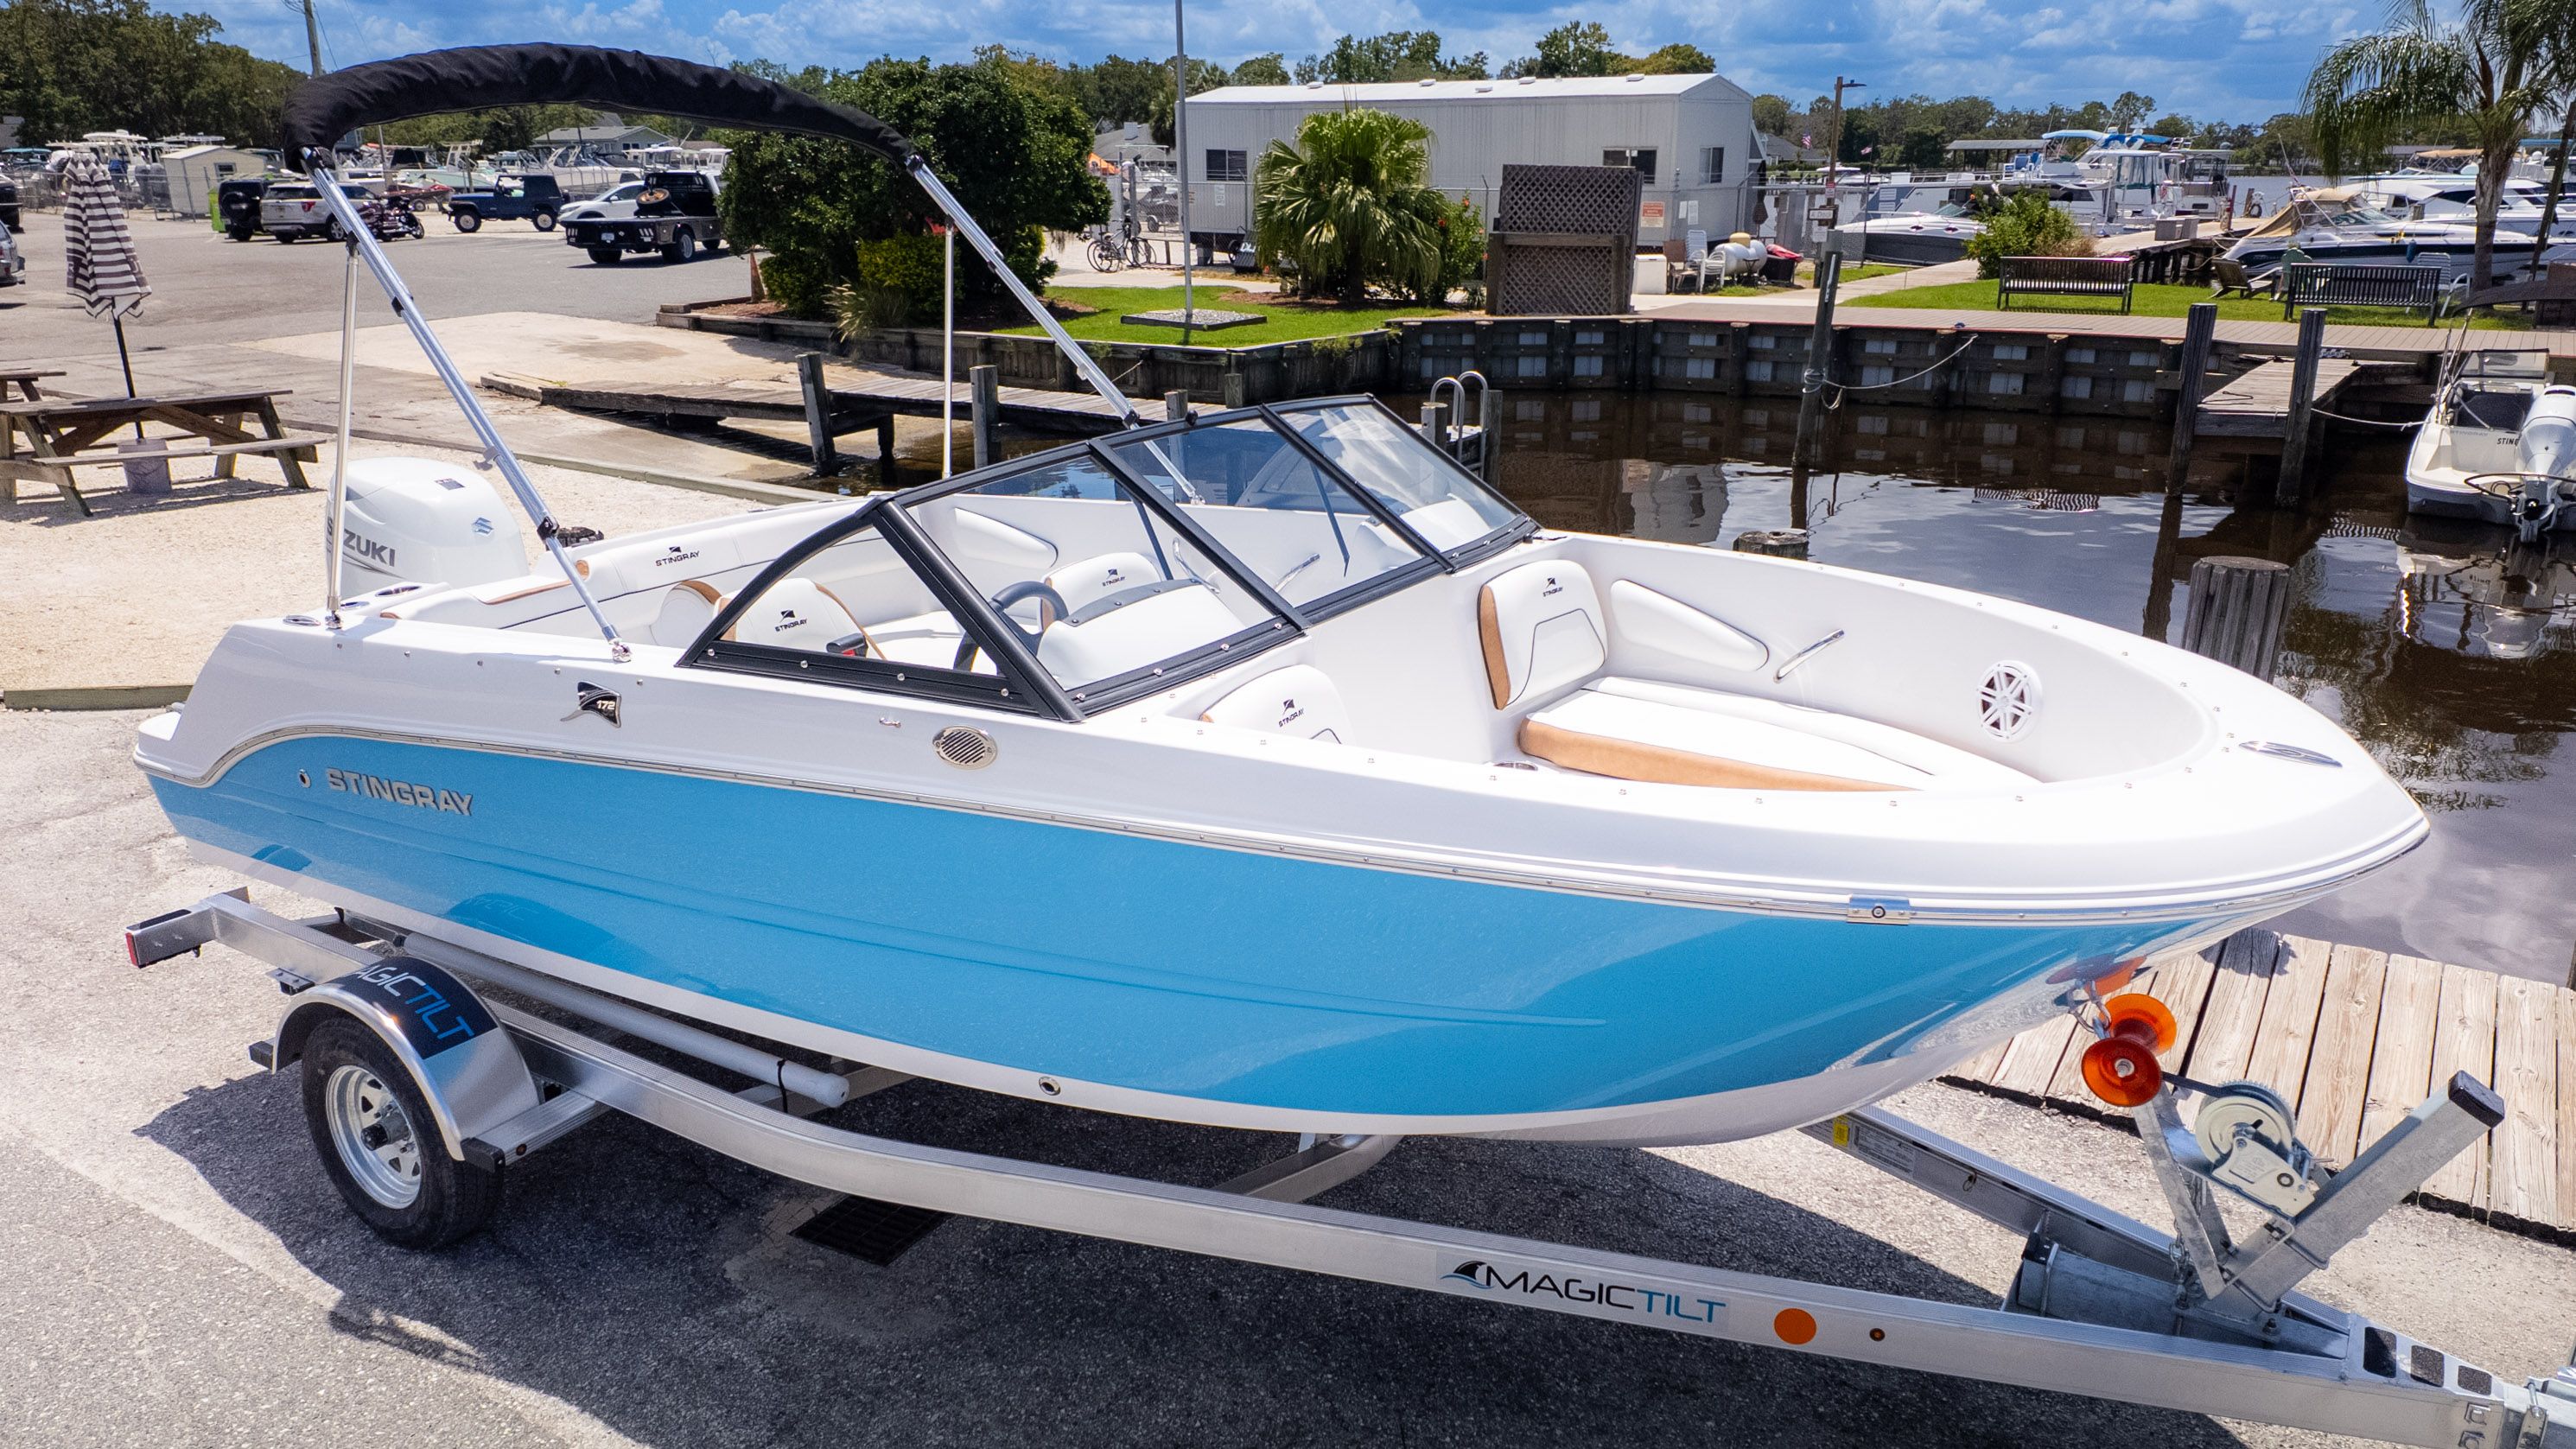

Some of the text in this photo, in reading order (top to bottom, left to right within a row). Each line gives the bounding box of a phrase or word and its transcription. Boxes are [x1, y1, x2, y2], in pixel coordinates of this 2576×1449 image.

[327, 516, 396, 567] SZUKI
[656, 550, 700, 567] STINGRAY
[774, 619, 807, 632] STINGRAY
[596, 700, 616, 710] 172
[326, 766, 473, 817] STINGRAY
[354, 964, 475, 1040] AGICTILT
[1485, 1265, 1727, 1323] MAGICTILT
